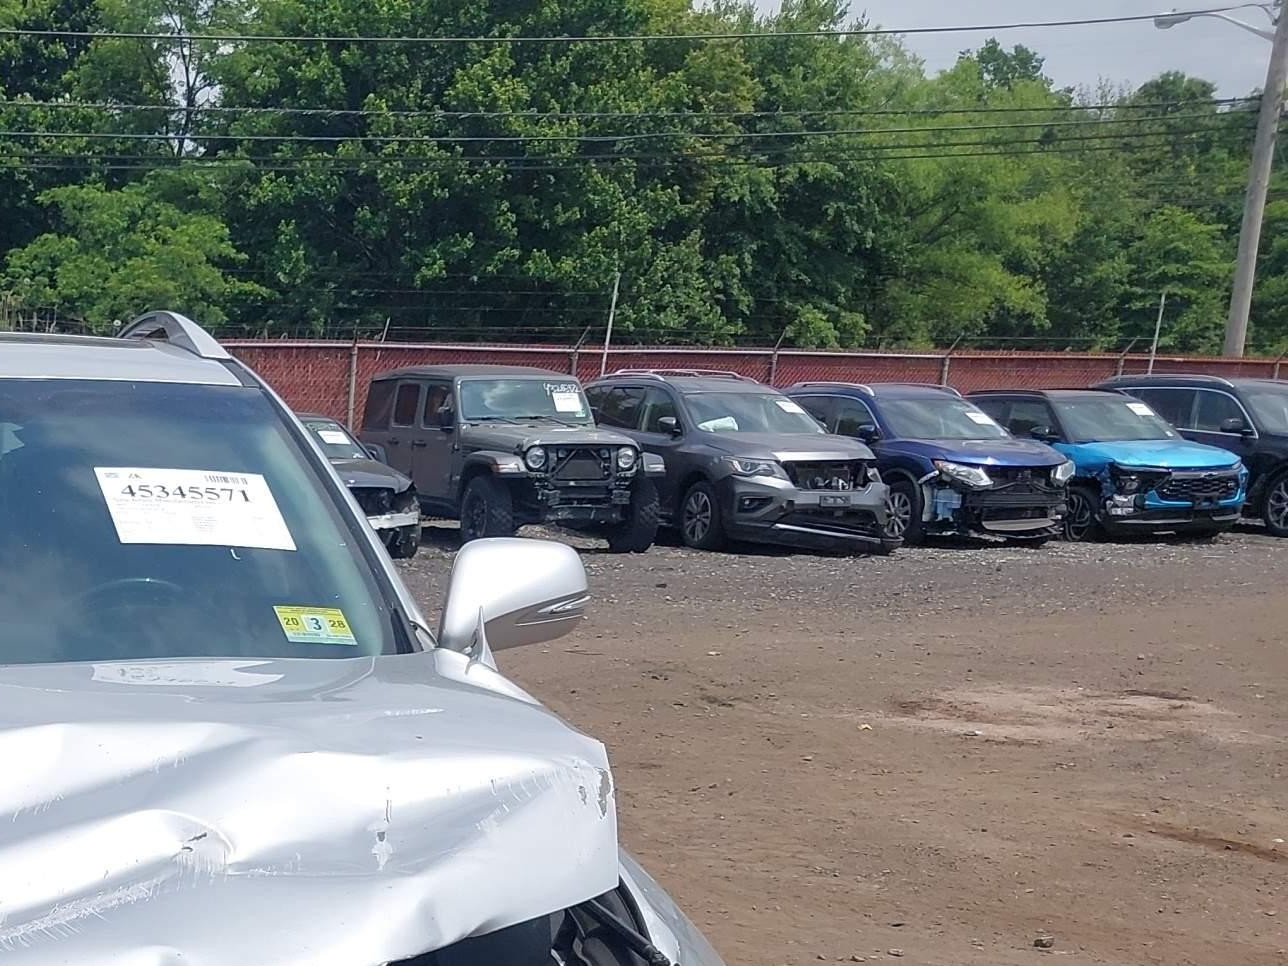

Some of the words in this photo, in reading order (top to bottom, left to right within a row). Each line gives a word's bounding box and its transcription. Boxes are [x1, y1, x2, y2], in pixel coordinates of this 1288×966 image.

[120, 484, 252, 502] 45345571
[283, 617, 299, 626] 20
[310, 617, 322, 631] 3
[329, 619, 346, 629] 28
